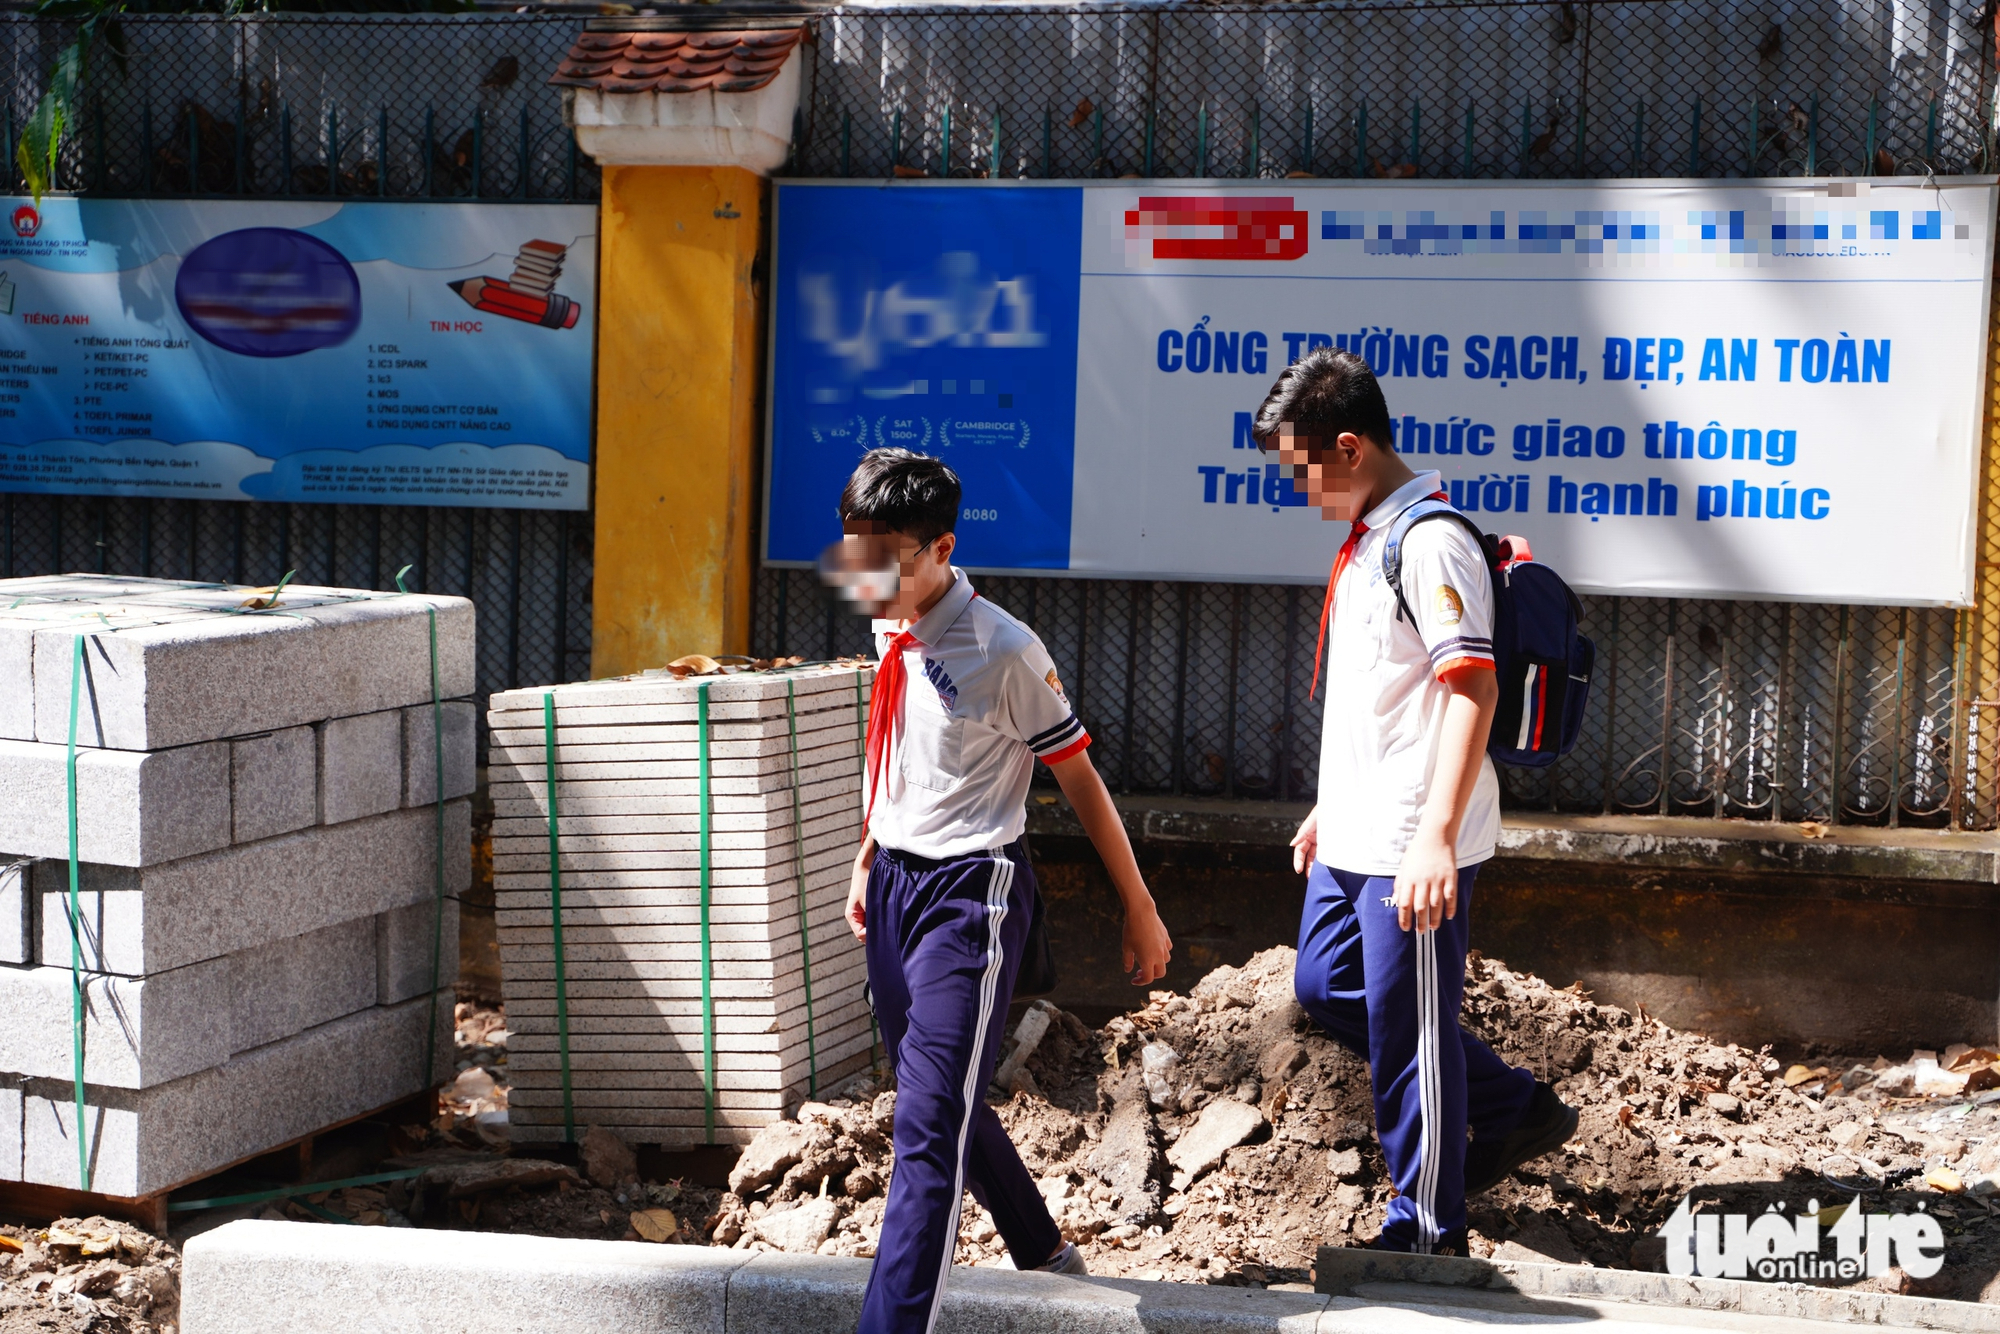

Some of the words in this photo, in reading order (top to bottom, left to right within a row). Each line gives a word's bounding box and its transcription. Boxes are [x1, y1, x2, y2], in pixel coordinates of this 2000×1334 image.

[22, 311, 60, 325] TIẾNG
[62, 314, 89, 325] ANH
[429, 320, 450, 332] TIN
[454, 321, 483, 334] HỌC
[81, 336, 110, 347] TIẾNG
[111, 338, 132, 347] ANH
[163, 338, 190, 349] QUÁT
[378, 344, 400, 354] ICDL
[1157, 315, 1268, 374] CỔNG
[1464, 335, 1587, 388] SẠCH,
[1603, 337, 1684, 390] ĐẸP,
[1698, 338, 1758, 382] AN
[1774, 332, 1891, 383] TOÀN
[94, 352, 149, 363] KET/KET-PC
[378, 359, 393, 368] IC3
[395, 359, 428, 369] SPARK
[41, 366, 58, 375] NHI
[94, 367, 148, 377] PET/PET-PC
[94, 381, 129, 392] FCE-PC
[378, 389, 399, 398] MOS
[84, 396, 102, 405] PTE
[432, 405, 457, 415] CNTT
[84, 412, 114, 421] TOEFL
[431, 420, 457, 430] CNTT
[490, 421, 512, 431] CAO
[893, 419, 913, 428] SAT
[954, 421, 1016, 431] CAMBRIDGE
[84, 426, 114, 435] TOEFL
[116, 426, 151, 436] JUNIOR
[891, 430, 918, 439] 1500+
[1512, 418, 1626, 462] giao
[1643, 420, 1797, 467] thông
[1547, 475, 1678, 523] hạnh
[1696, 479, 1830, 521] phúc
[962, 507, 998, 521] 8080
